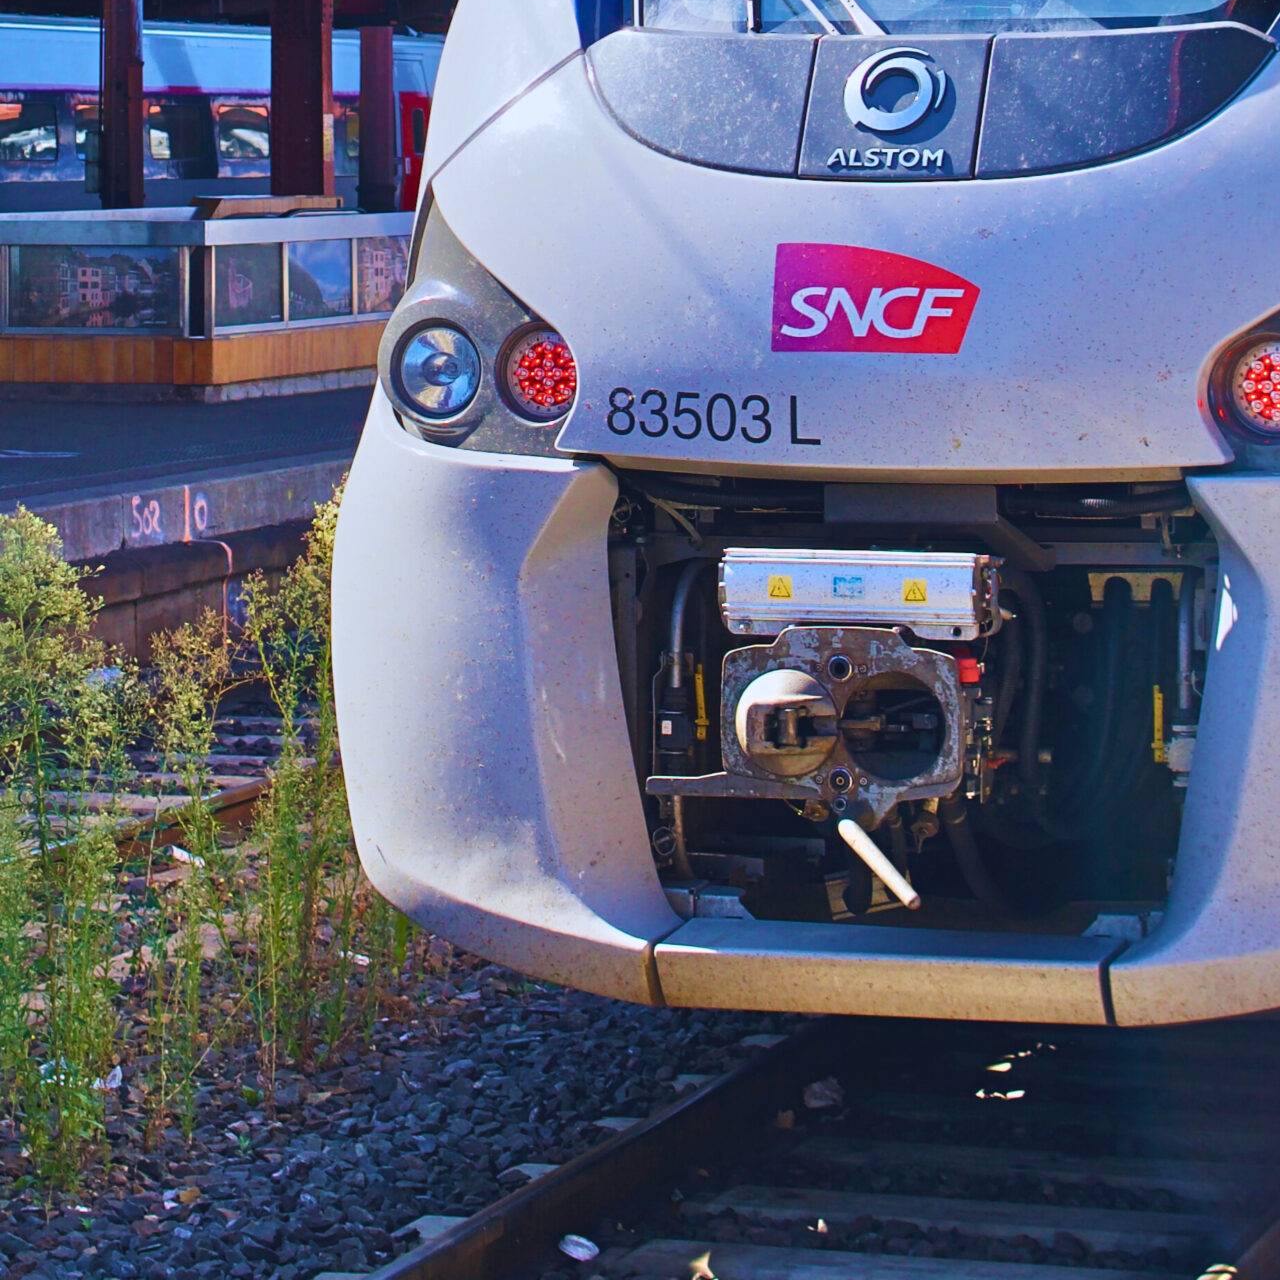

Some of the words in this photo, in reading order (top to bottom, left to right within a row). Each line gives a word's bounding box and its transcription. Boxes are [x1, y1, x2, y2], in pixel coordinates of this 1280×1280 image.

[826, 148, 944, 168] ALSTOM
[780, 286, 964, 339] SNCF
[607, 387, 772, 444] 83503
[789, 395, 821, 446] L
